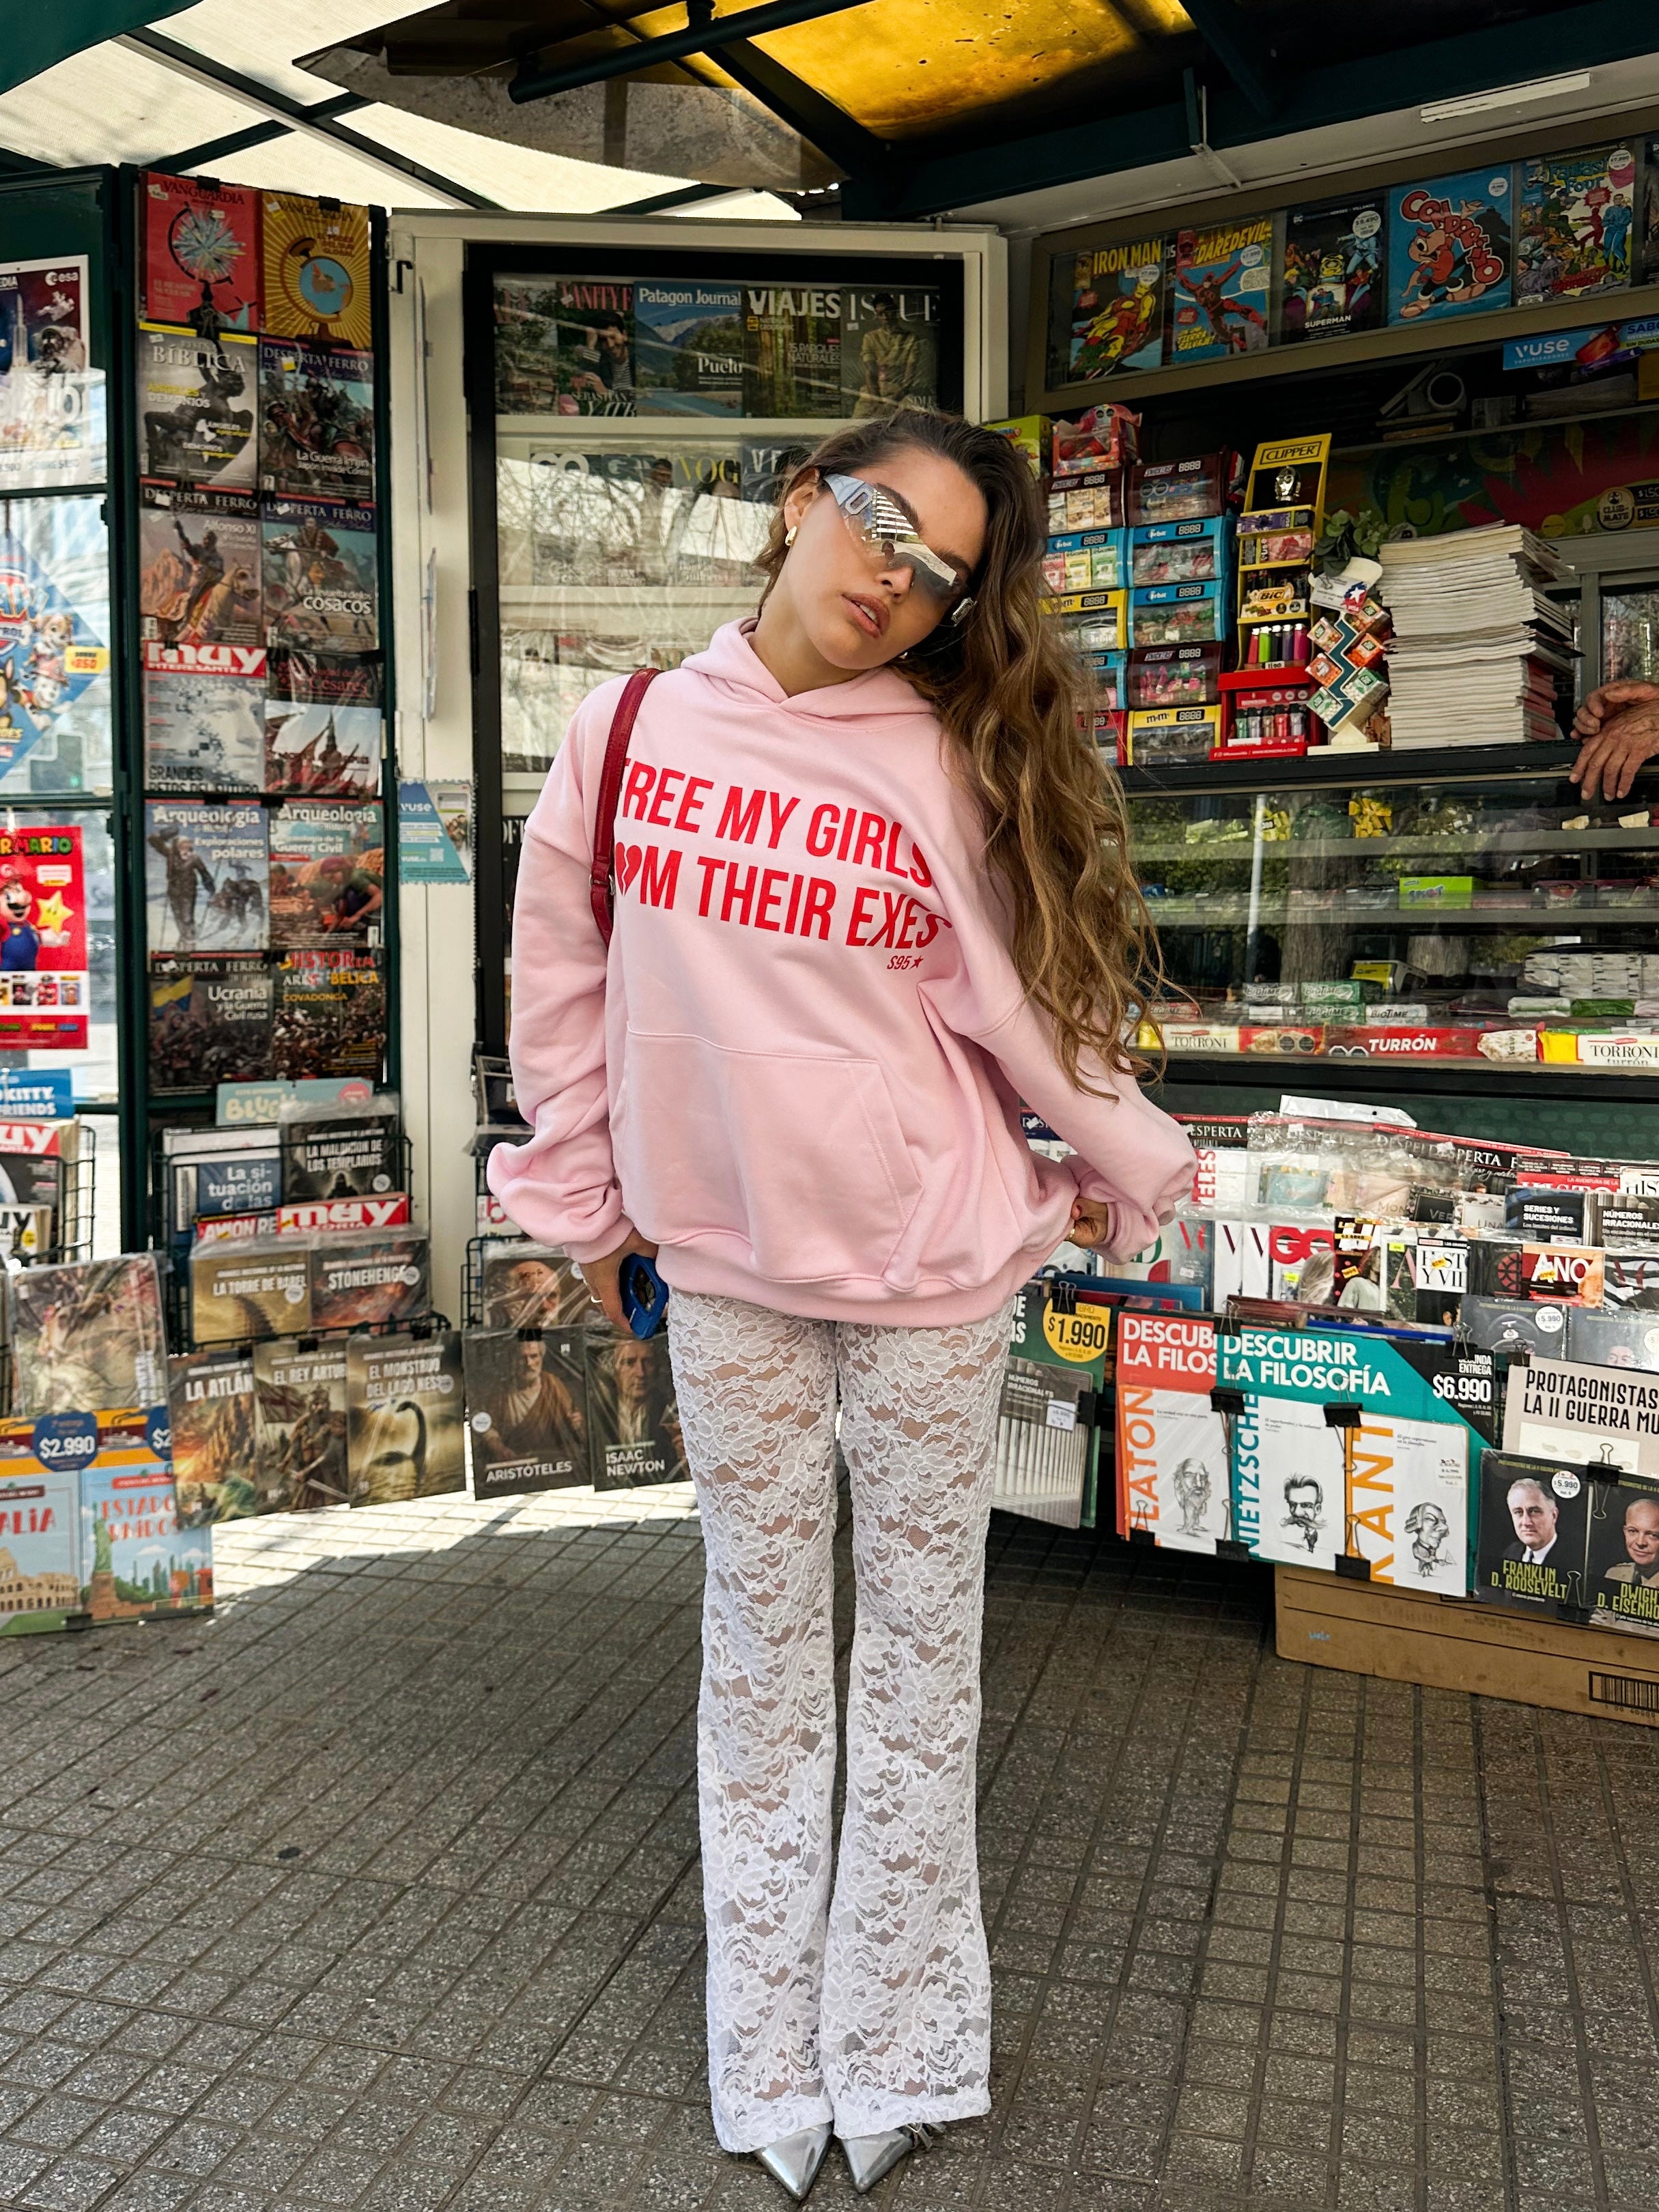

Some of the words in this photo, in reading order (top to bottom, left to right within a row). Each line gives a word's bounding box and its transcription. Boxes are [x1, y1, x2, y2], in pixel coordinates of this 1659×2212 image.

[1195, 221, 1271, 265] DAREDEVIL
[1094, 246, 1127, 274] IRON
[1129, 239, 1161, 268] MAN
[638, 287, 692, 307] Patagon
[696, 289, 741, 307] Journal
[748, 289, 841, 319] VIAJES
[1304, 315, 1352, 329] SUPERMAN
[1516, 339, 1570, 358] vuse
[153, 344, 246, 374] BÍBLICA
[328, 358, 369, 372] FERRO
[1266, 445, 1317, 461] CLIPPER
[215, 496, 257, 511] FERRO
[332, 508, 372, 522] FERRO
[148, 643, 266, 674] muy
[400, 802, 432, 812] vuse
[621, 757, 714, 834] REE
[715, 785, 801, 849] MY
[277, 804, 377, 823] Arqueología
[211, 848, 264, 861] polares
[696, 855, 837, 941] THEIR
[845, 886, 953, 950] EXES
[208, 986, 267, 1002] Ucrania
[283, 992, 348, 1004] COVADONGA
[1174, 1036, 1228, 1049] TORRONI
[1368, 1034, 1436, 1052] TURRÓN
[227, 1166, 246, 1180] La
[208, 1180, 272, 1197] tuación
[1523, 1204, 1552, 1214] SERIES
[1523, 1213, 1574, 1224] SUCESIONES
[1602, 1208, 1644, 1220] NÚMEROS
[1123, 1343, 1154, 1366] LA
[1223, 1335, 1358, 1369] DESCUBRIR
[1223, 1356, 1254, 1382] LA
[1260, 1360, 1391, 1397] FILOSOFÍA
[1458, 1363, 1492, 1376] ENTREGA
[185, 1380, 205, 1401] LA
[1432, 1374, 1492, 1402] $6.990
[1525, 1368, 1659, 1410] PROTAGONISTAS
[1523, 1392, 1543, 1415] LA
[1548, 1396, 1560, 1418] II
[1565, 1400, 1630, 1430] GUERRA
[39, 1435, 96, 1459] $2.990
[605, 1449, 644, 1464] ISAAC
[485, 1460, 573, 1483] ARISTÓTELES
[606, 1459, 666, 1477] NEWTON
[1503, 1559, 1557, 1584] FRANKLIN
[1491, 1572, 1503, 1588] D.
[1505, 1576, 1568, 1600] ROOSEVELT
[1597, 1592, 1608, 1608] D.
